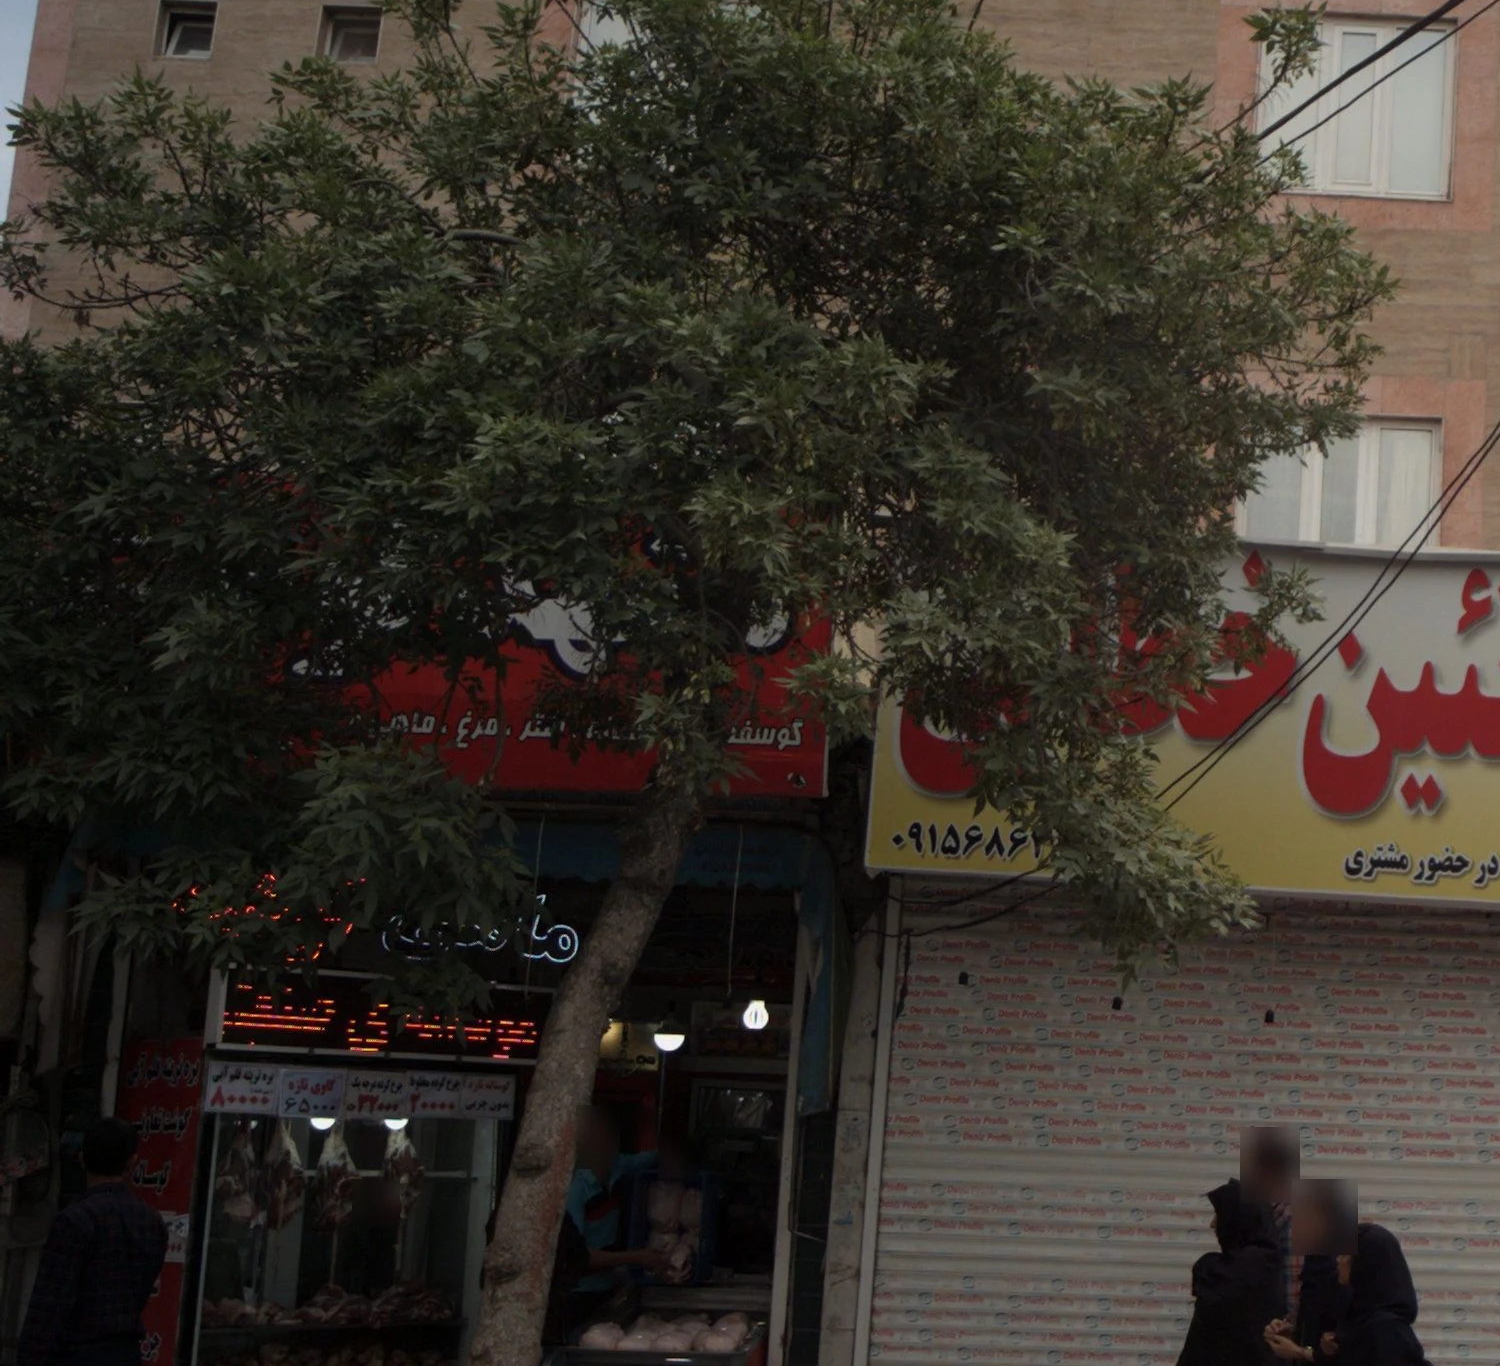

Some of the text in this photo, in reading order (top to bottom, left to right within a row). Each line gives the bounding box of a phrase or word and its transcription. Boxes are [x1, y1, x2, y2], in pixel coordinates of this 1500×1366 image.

[456, 710, 500, 749] مرغ
[727, 719, 805, 751] گوسفن
[1344, 843, 1410, 878] مشتری
[1413, 847, 1472, 883] حضور
[1475, 853, 1500, 885] در
[210, 1085, 270, 1108] ۸۰۰۰۰
[284, 1097, 336, 1113] ۶۵۰۰۰
